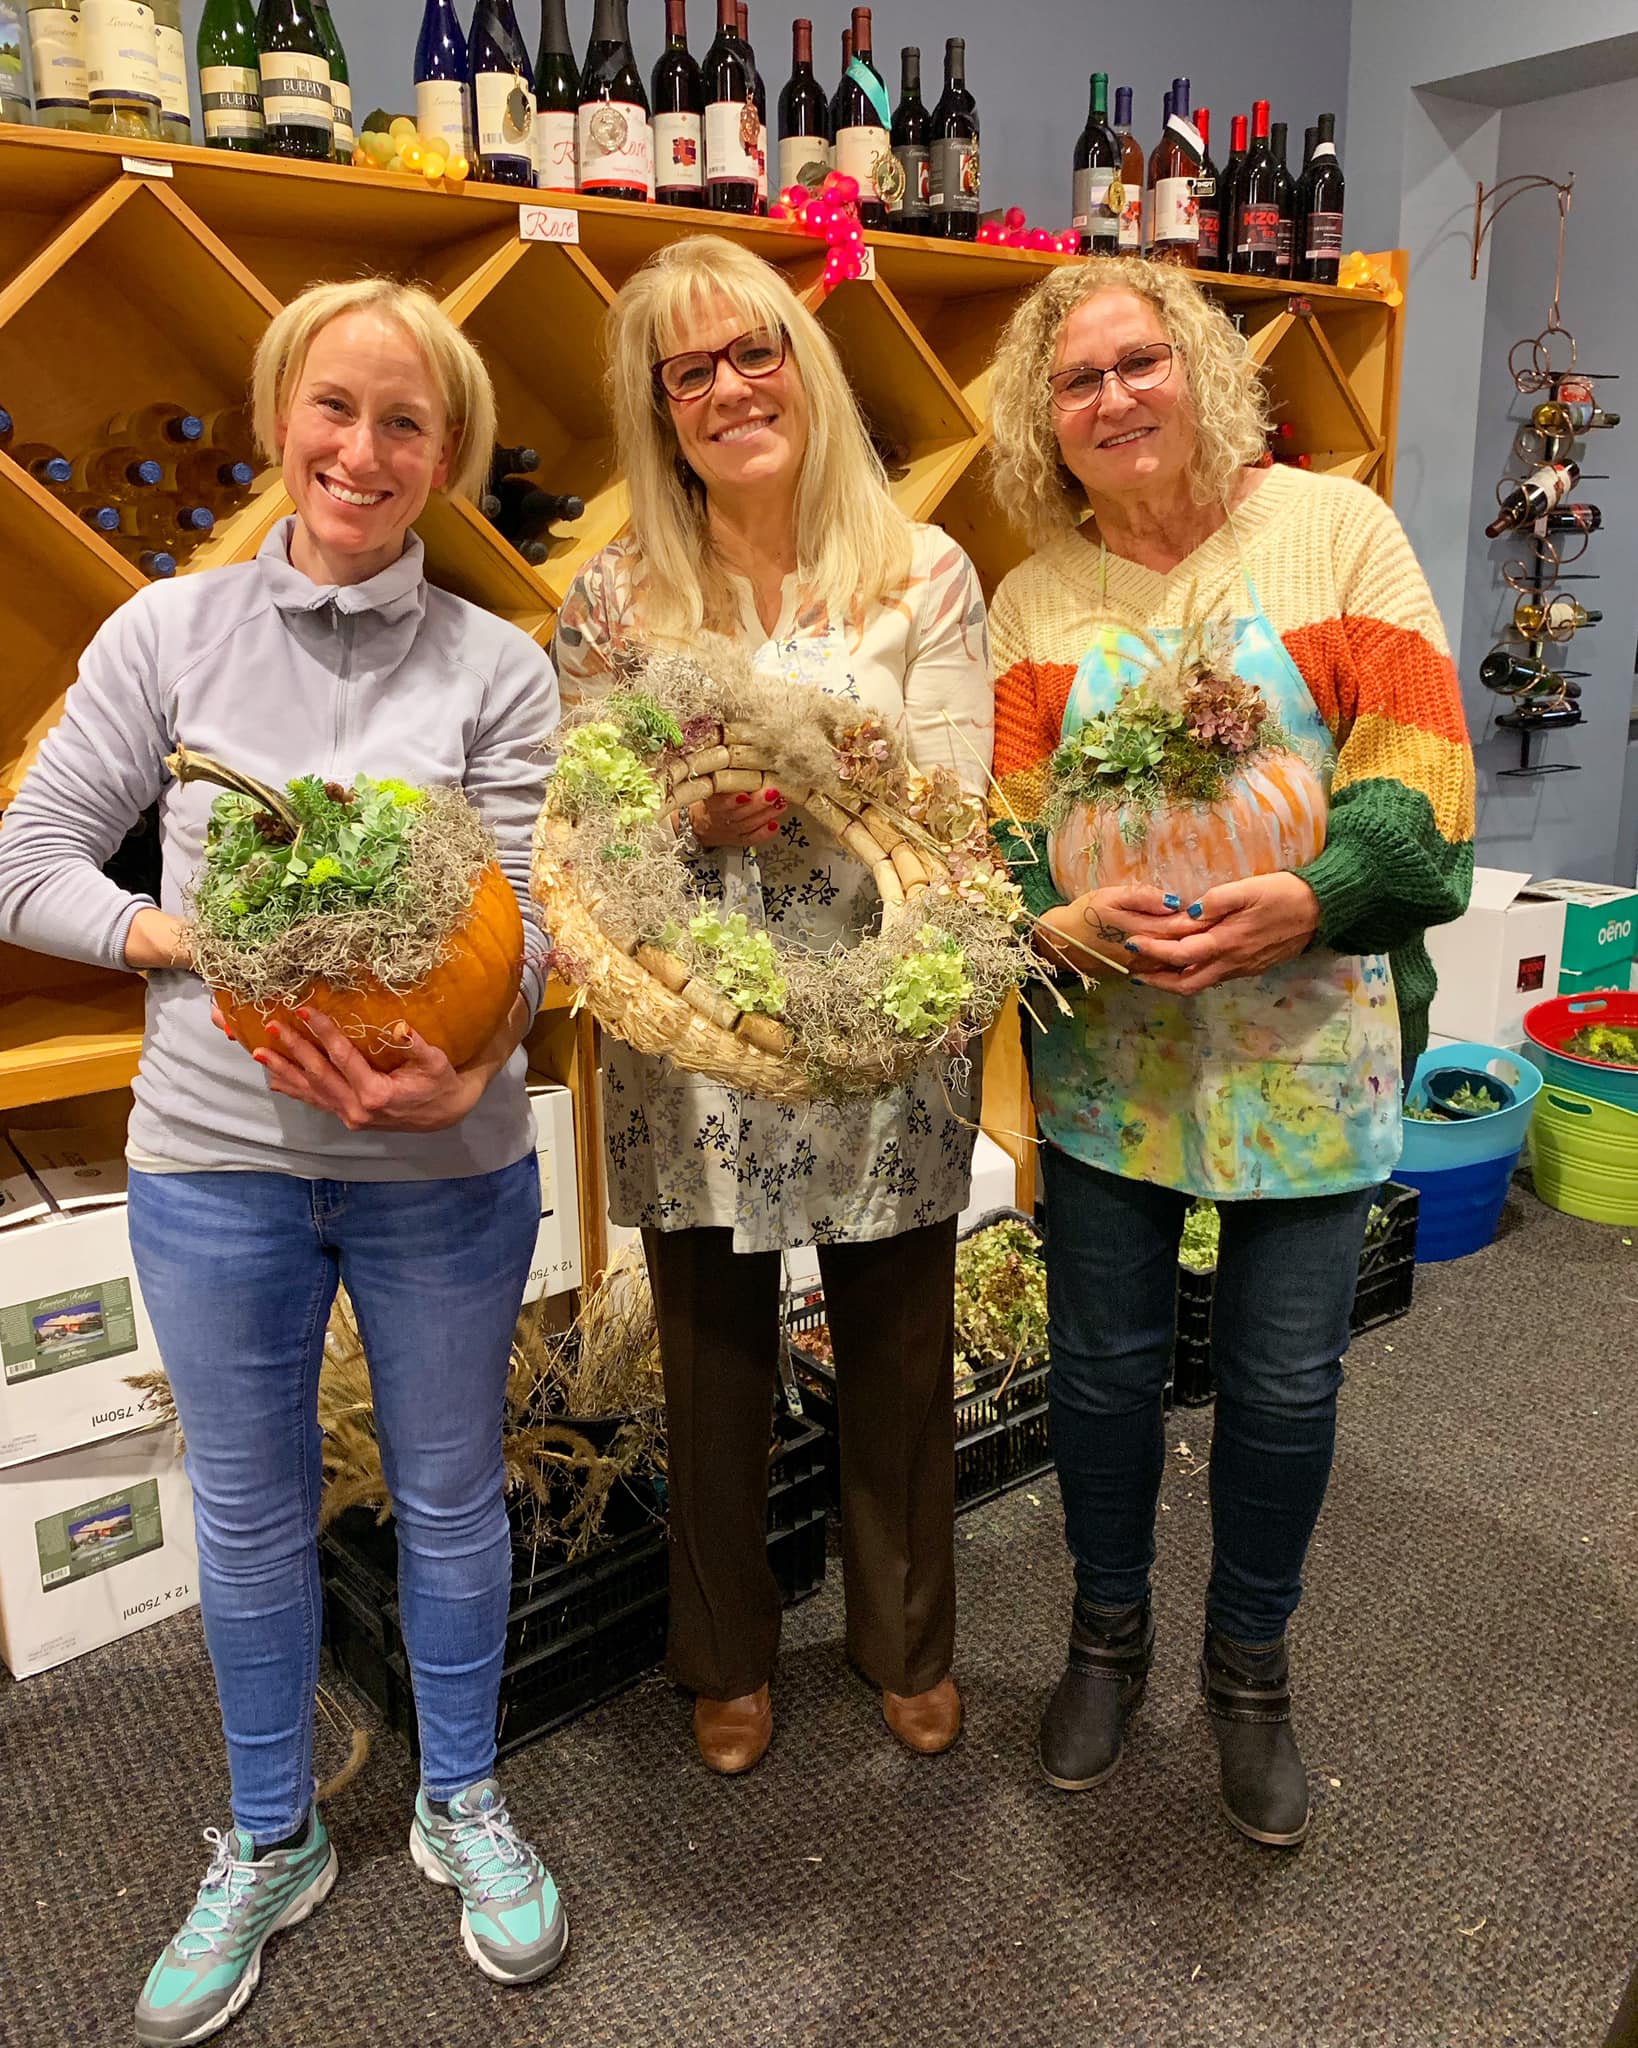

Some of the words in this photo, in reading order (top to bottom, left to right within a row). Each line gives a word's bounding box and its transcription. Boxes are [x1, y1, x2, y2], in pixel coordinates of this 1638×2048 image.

[552, 1264, 559, 1272] x
[561, 1260, 572, 1272] 12
[137, 1402, 145, 1413] x
[91, 1404, 134, 1428] 750ml
[164, 1590, 172, 1601] x
[175, 1585, 189, 1596] 12
[122, 1596, 161, 1621] 750ml
